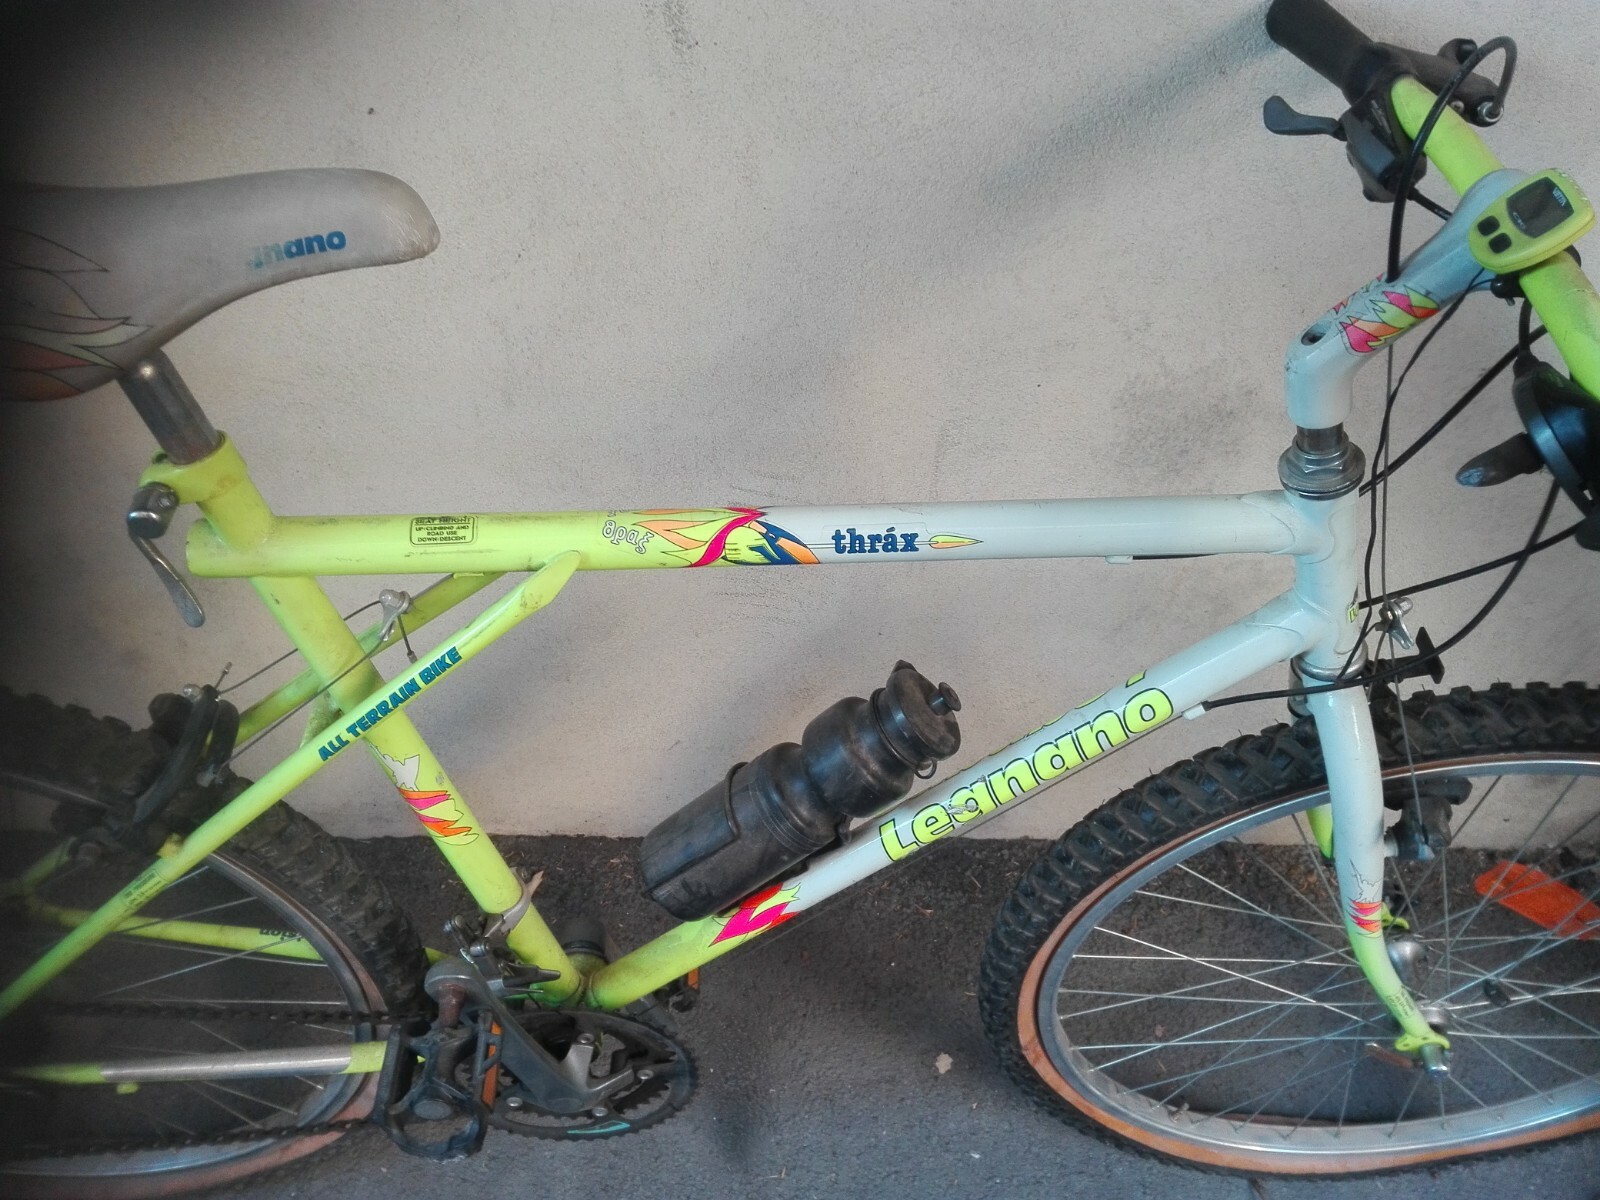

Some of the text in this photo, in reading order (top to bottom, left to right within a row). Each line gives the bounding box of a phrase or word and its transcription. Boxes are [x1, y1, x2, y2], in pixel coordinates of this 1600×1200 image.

[831, 526, 920, 554] thráx
[318, 646, 462, 762] ALL TERRAIN BIKE
